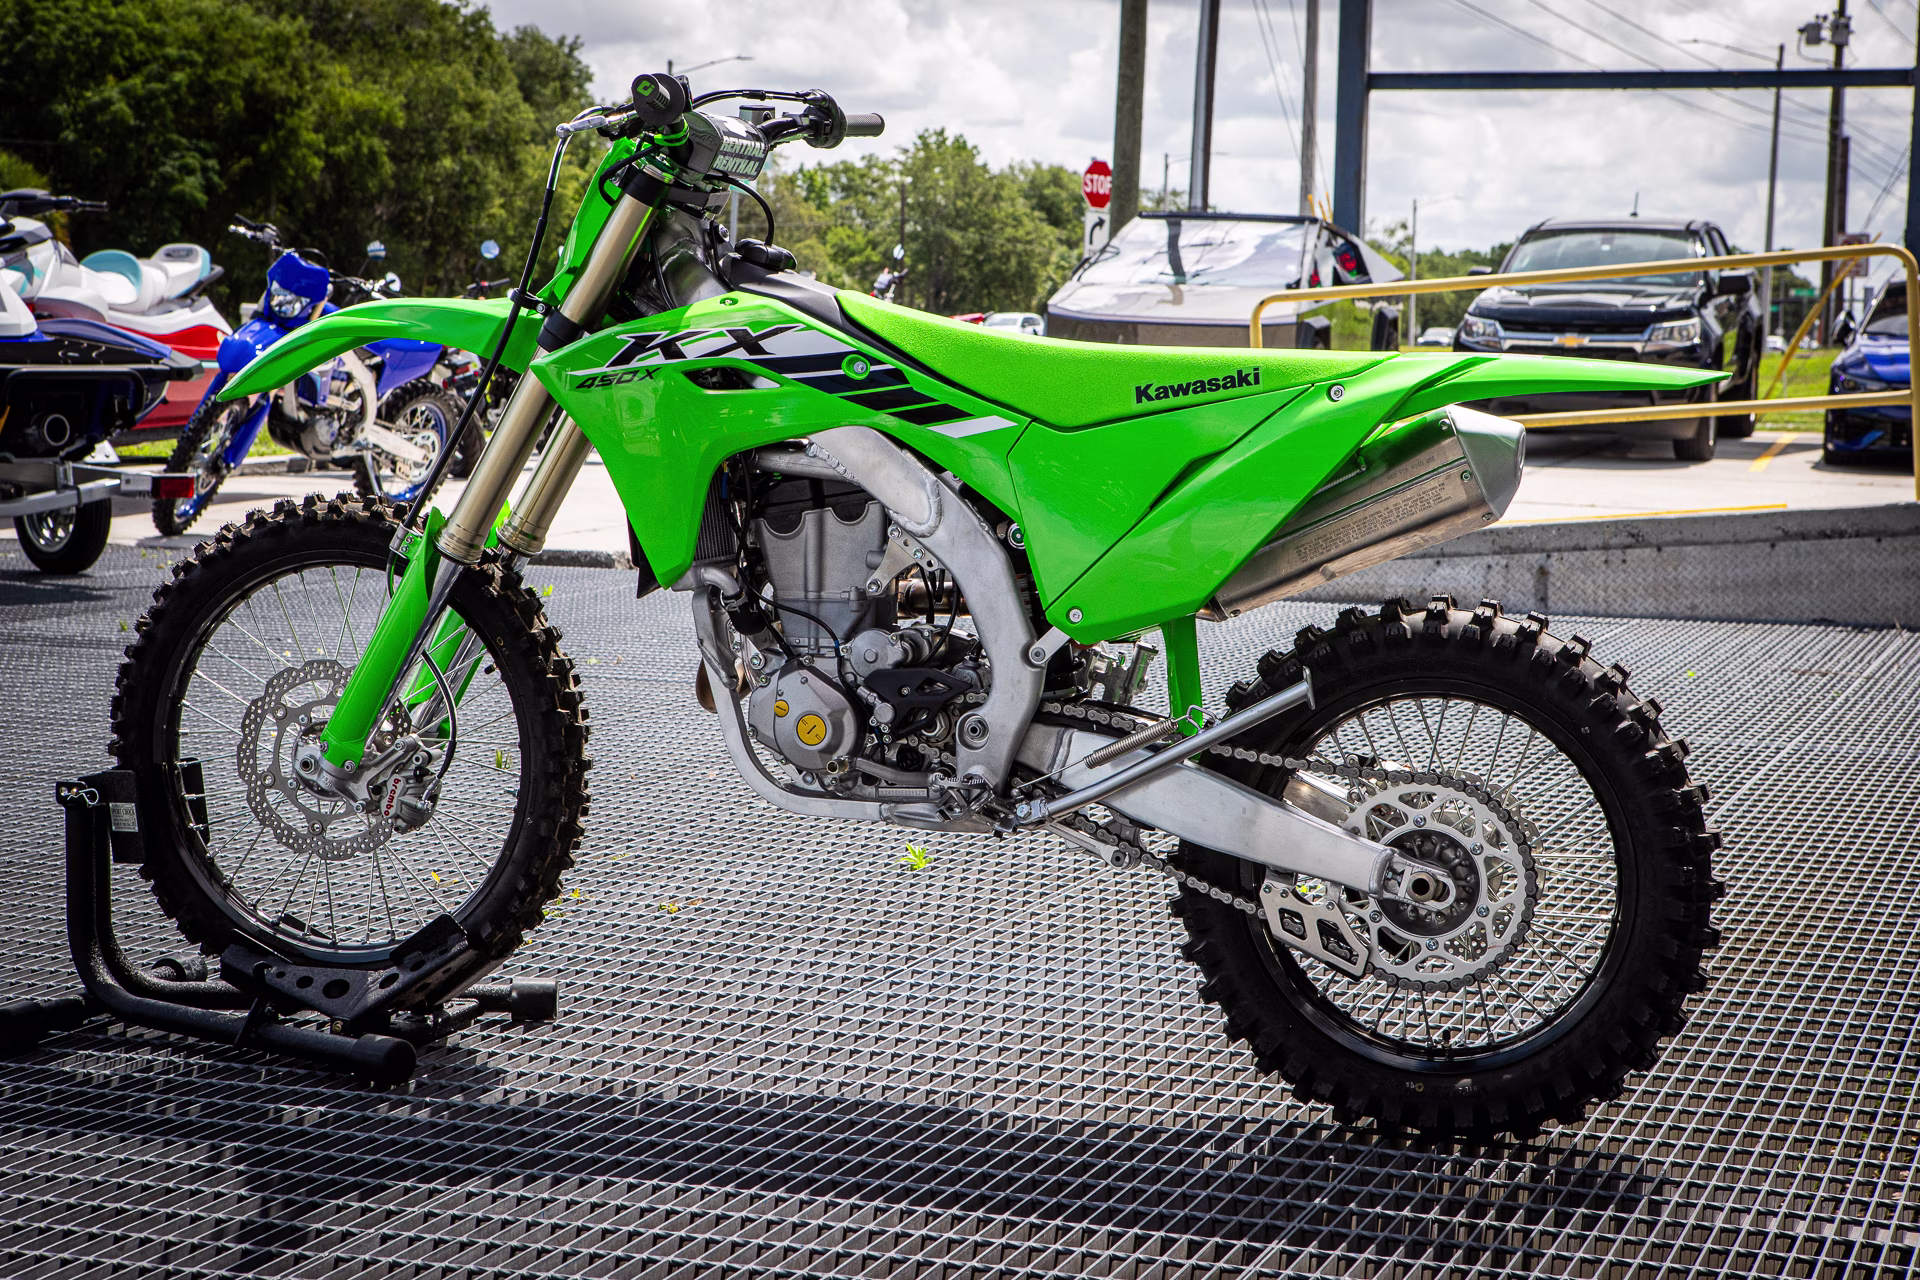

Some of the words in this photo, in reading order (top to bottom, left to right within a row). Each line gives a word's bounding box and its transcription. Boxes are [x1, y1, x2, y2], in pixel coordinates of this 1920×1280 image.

[720, 136, 765, 158] RENTHAL
[713, 154, 760, 175] RENTHAL
[605, 326, 803, 368] KX
[576, 367, 662, 390] 450X
[1135, 368, 1260, 404] Kawasaki
[384, 778, 401, 816] brembo
